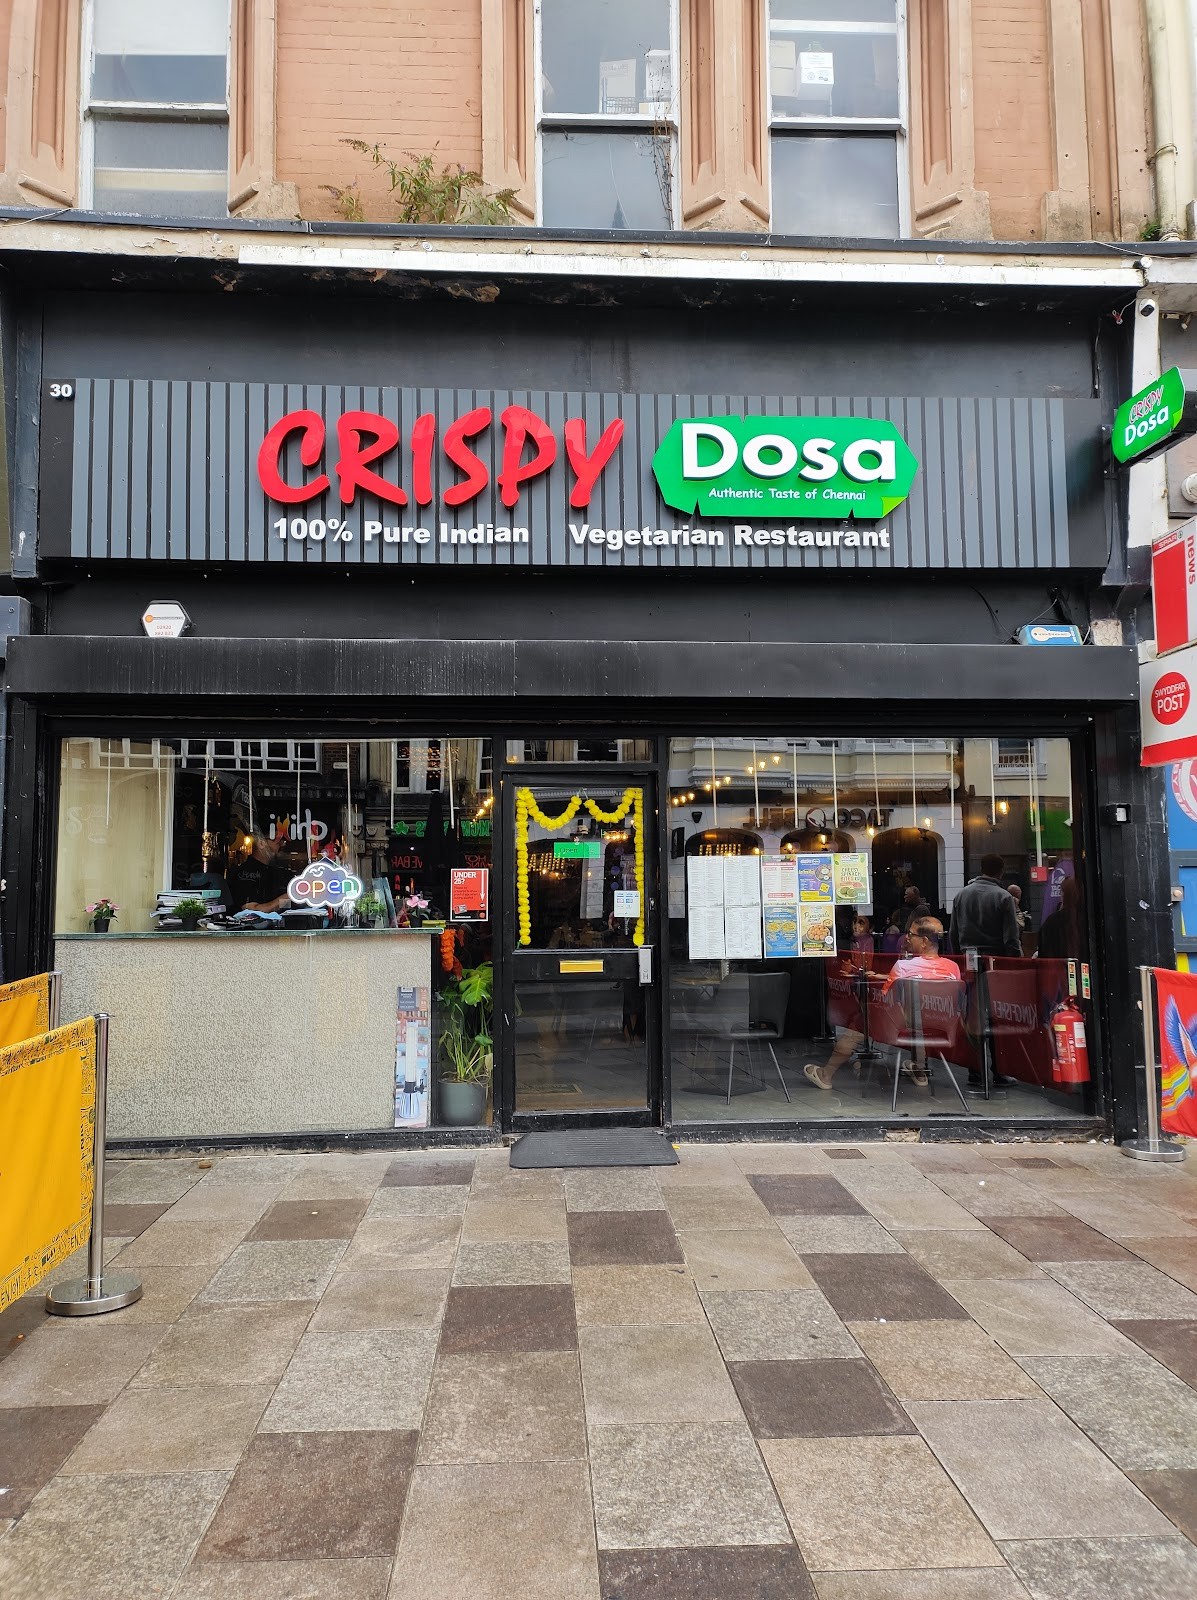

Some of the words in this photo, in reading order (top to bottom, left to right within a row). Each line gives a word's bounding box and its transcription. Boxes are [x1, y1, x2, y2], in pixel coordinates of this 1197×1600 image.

[49, 383, 73, 398] 30
[1129, 384, 1164, 424] CRISPY
[1125, 405, 1169, 447] Dosa
[257, 404, 625, 508] CRISPY
[682, 423, 896, 483] Dosa
[708, 486, 764, 500] Authentic
[768, 487, 801, 500] Taste
[804, 487, 818, 500] of
[822, 487, 866, 501] Chennai
[273, 518, 353, 542] 100%
[363, 521, 431, 544] Pure
[439, 521, 529, 544] Indian
[569, 523, 724, 551] Vegetarian
[734, 525, 890, 548] Restaurant
[1158, 534, 1178, 549] SPAR
[1187, 535, 1196, 585] news
[1157, 693, 1185, 715] POST
[295, 879, 355, 898] open
